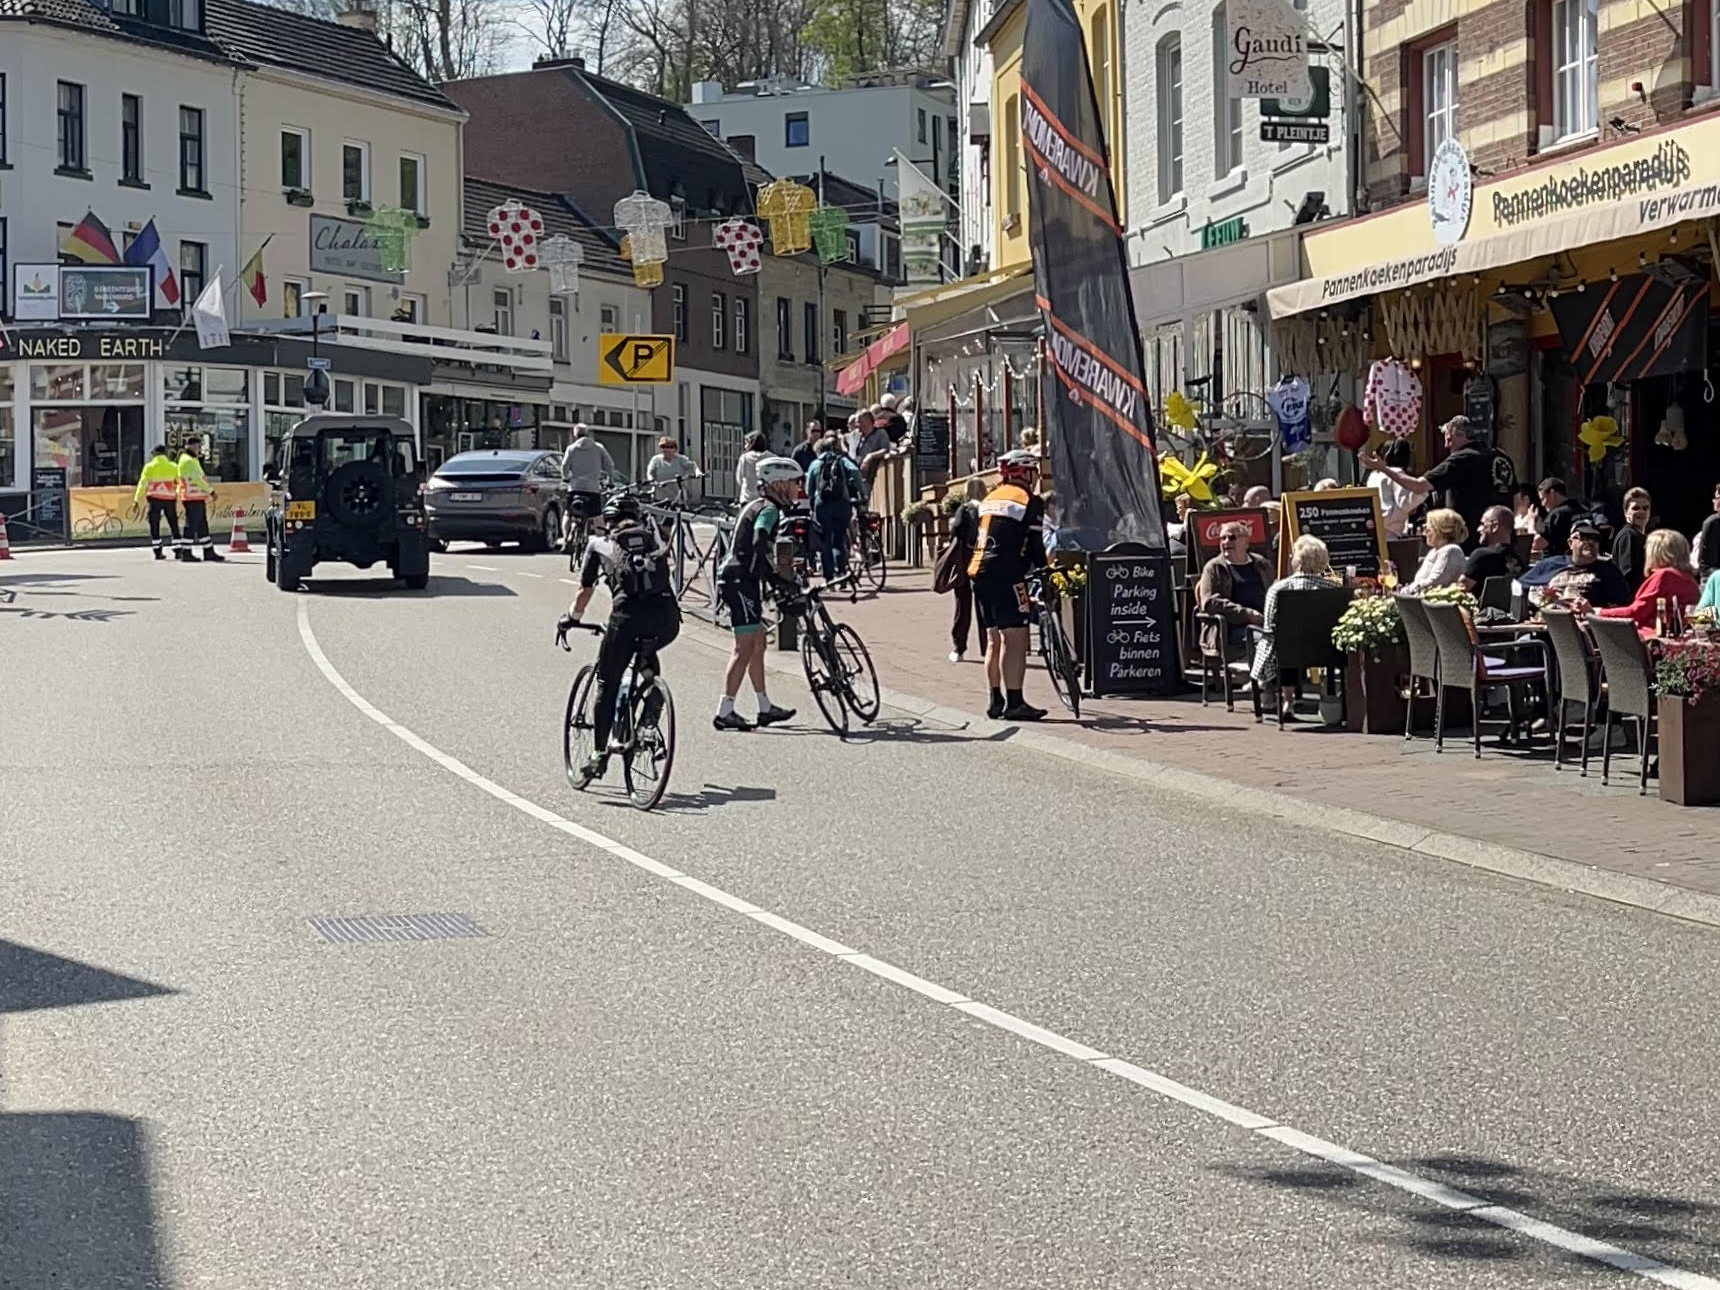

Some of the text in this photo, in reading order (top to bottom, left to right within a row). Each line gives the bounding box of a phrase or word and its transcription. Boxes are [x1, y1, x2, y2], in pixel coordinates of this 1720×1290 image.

[1247, 81, 1288, 95] Hotel
[1277, 126, 1328, 141] PLEINTJE
[1323, 245, 1457, 299] Pannenkoekenparadijs
[19, 338, 163, 357] NAKED EARTH
[633, 344, 655, 367] P
[1299, 507, 1320, 519] 250
[1132, 567, 1155, 579] Bike
[1113, 584, 1157, 601] Parking
[1110, 603, 1147, 616] inside
[1133, 631, 1160, 643] Fiets
[1120, 648, 1160, 659] binnen
